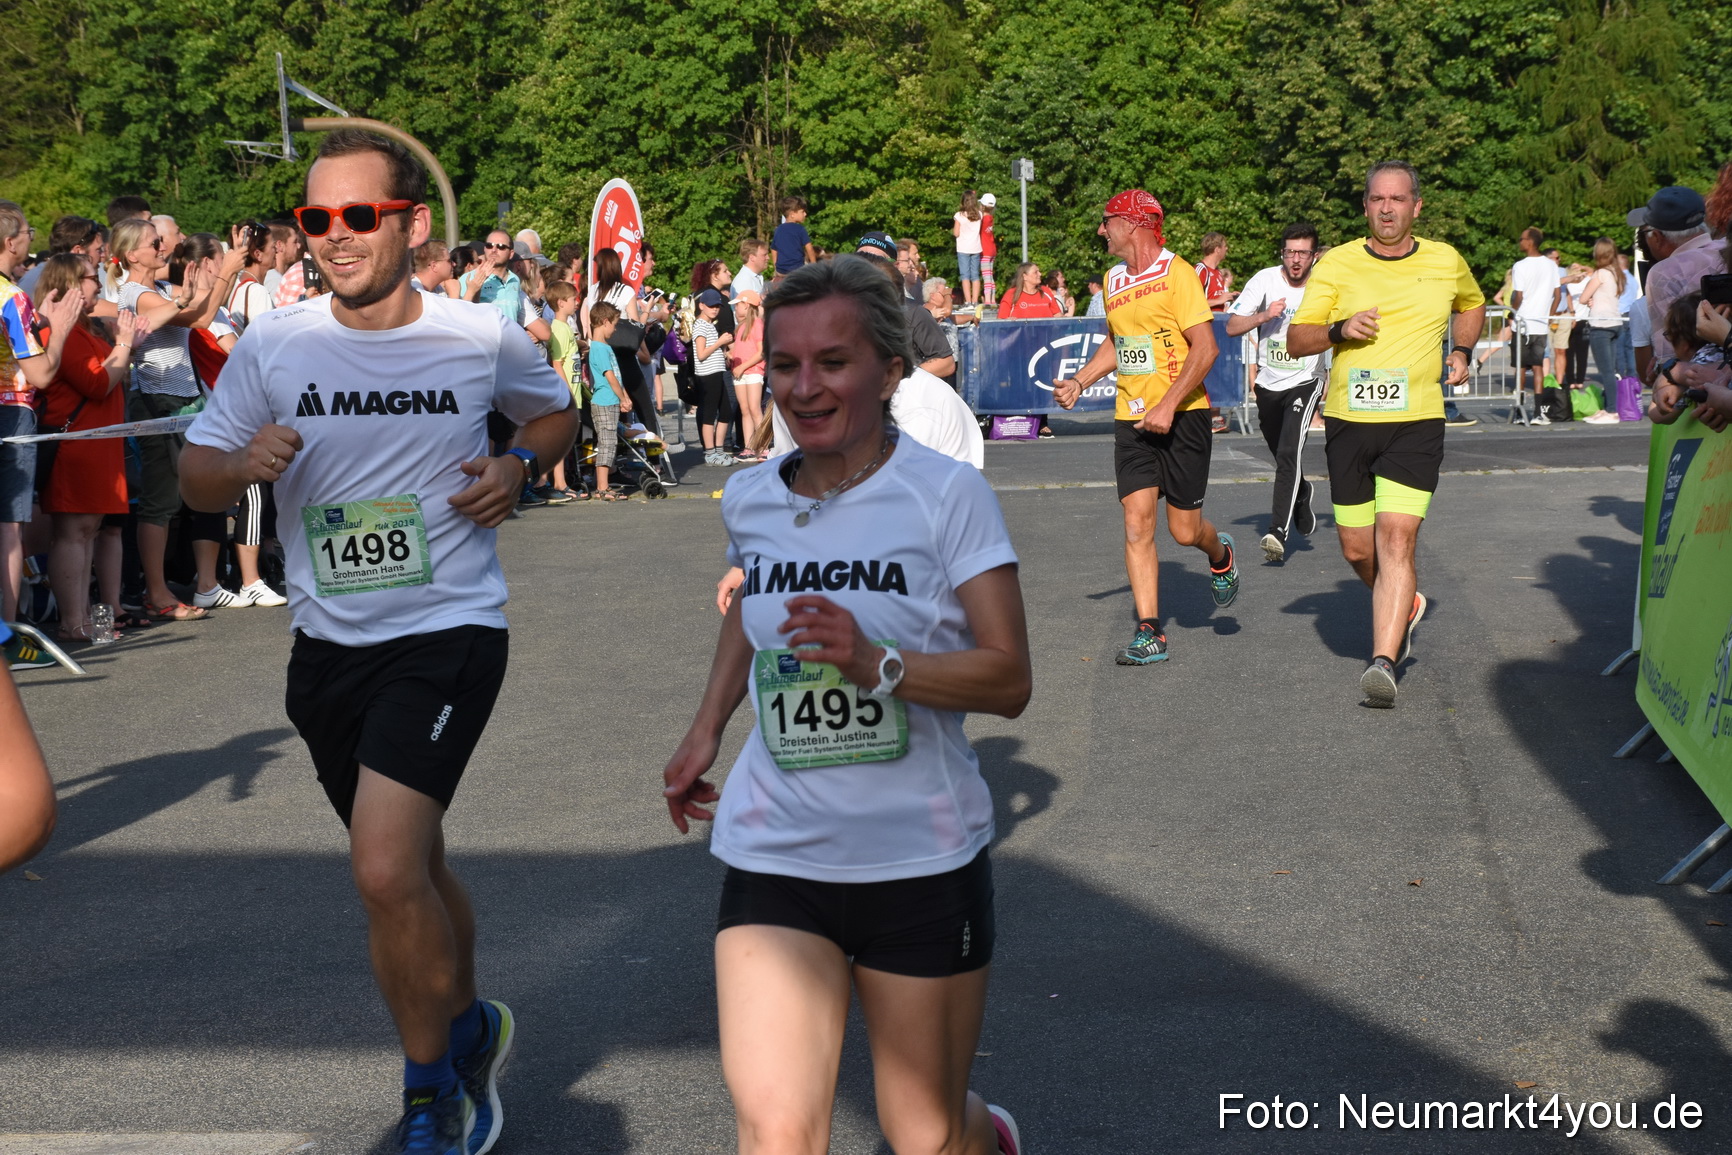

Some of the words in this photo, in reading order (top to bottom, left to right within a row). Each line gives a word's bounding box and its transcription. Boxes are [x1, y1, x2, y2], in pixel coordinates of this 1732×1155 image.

[604, 199, 615, 224] AVIA
[1106, 294, 1132, 314] MAX
[1134, 281, 1169, 300] BÖGL
[1118, 349, 1148, 364] 1599
[1354, 383, 1400, 400] 2192
[330, 389, 460, 417] MAGNA
[392, 518, 415, 528] 2019
[321, 529, 410, 570] 1498
[332, 568, 378, 579] Grohmann
[380, 564, 405, 574] Hans
[358, 576, 379, 584] Systems
[398, 569, 423, 577] Neumarkt
[764, 559, 909, 597] MAGNA
[770, 669, 824, 684] firmenlauf
[771, 687, 884, 735] 1495
[430, 704, 453, 741] adidas
[779, 734, 829, 748] Dreistein
[832, 730, 878, 743] Justina
[782, 748, 797, 757] Steyr
[814, 745, 842, 755] Systems
[844, 742, 865, 751] GmbH
[866, 739, 900, 749] Neumarkt
